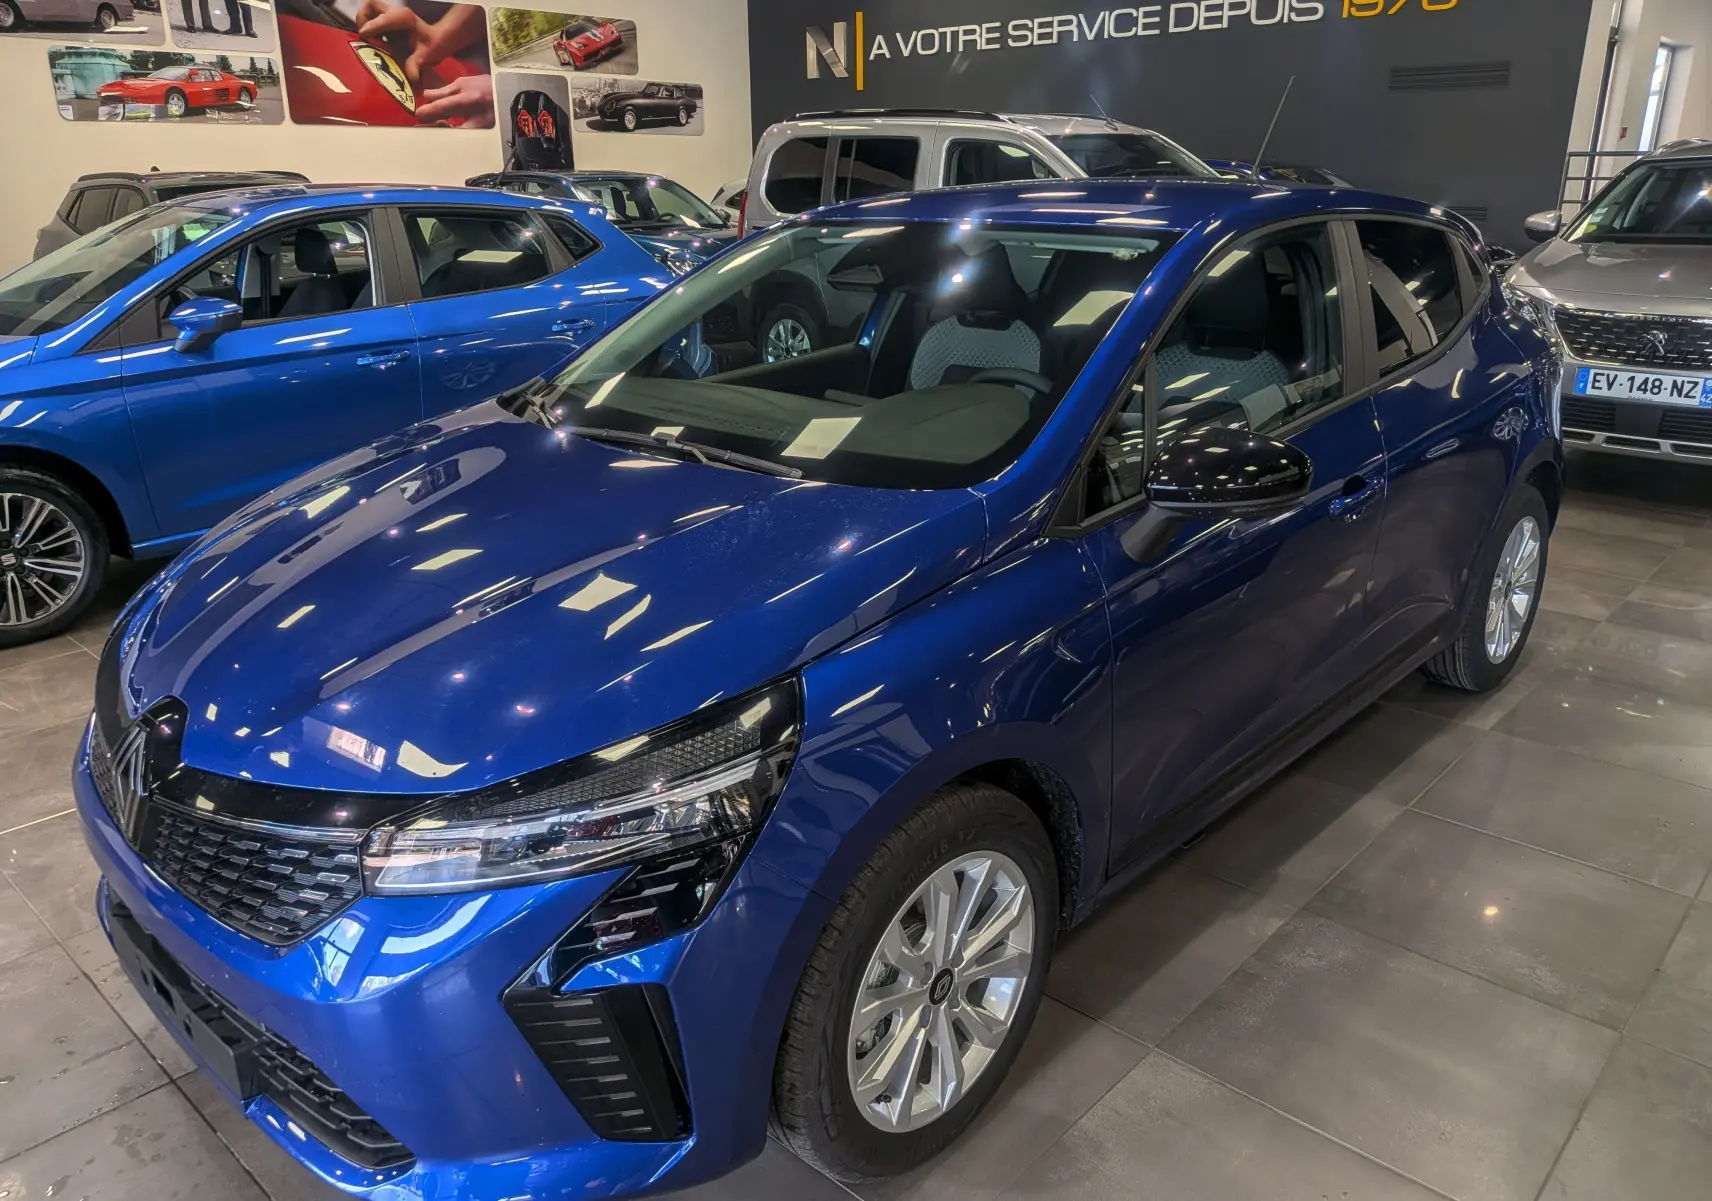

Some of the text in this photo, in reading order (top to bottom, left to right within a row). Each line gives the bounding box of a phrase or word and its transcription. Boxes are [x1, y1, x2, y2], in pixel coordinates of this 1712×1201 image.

[806, 21, 849, 79] N
[868, 34, 891, 60] A
[896, 22, 1001, 57] VOTRE
[1007, 6, 1161, 47] SERVICE
[1168, 0, 1324, 33] DEPUIS
[1590, 372, 1700, 400] EV-148-NZ
[1700, 393, 1712, 403] 42
